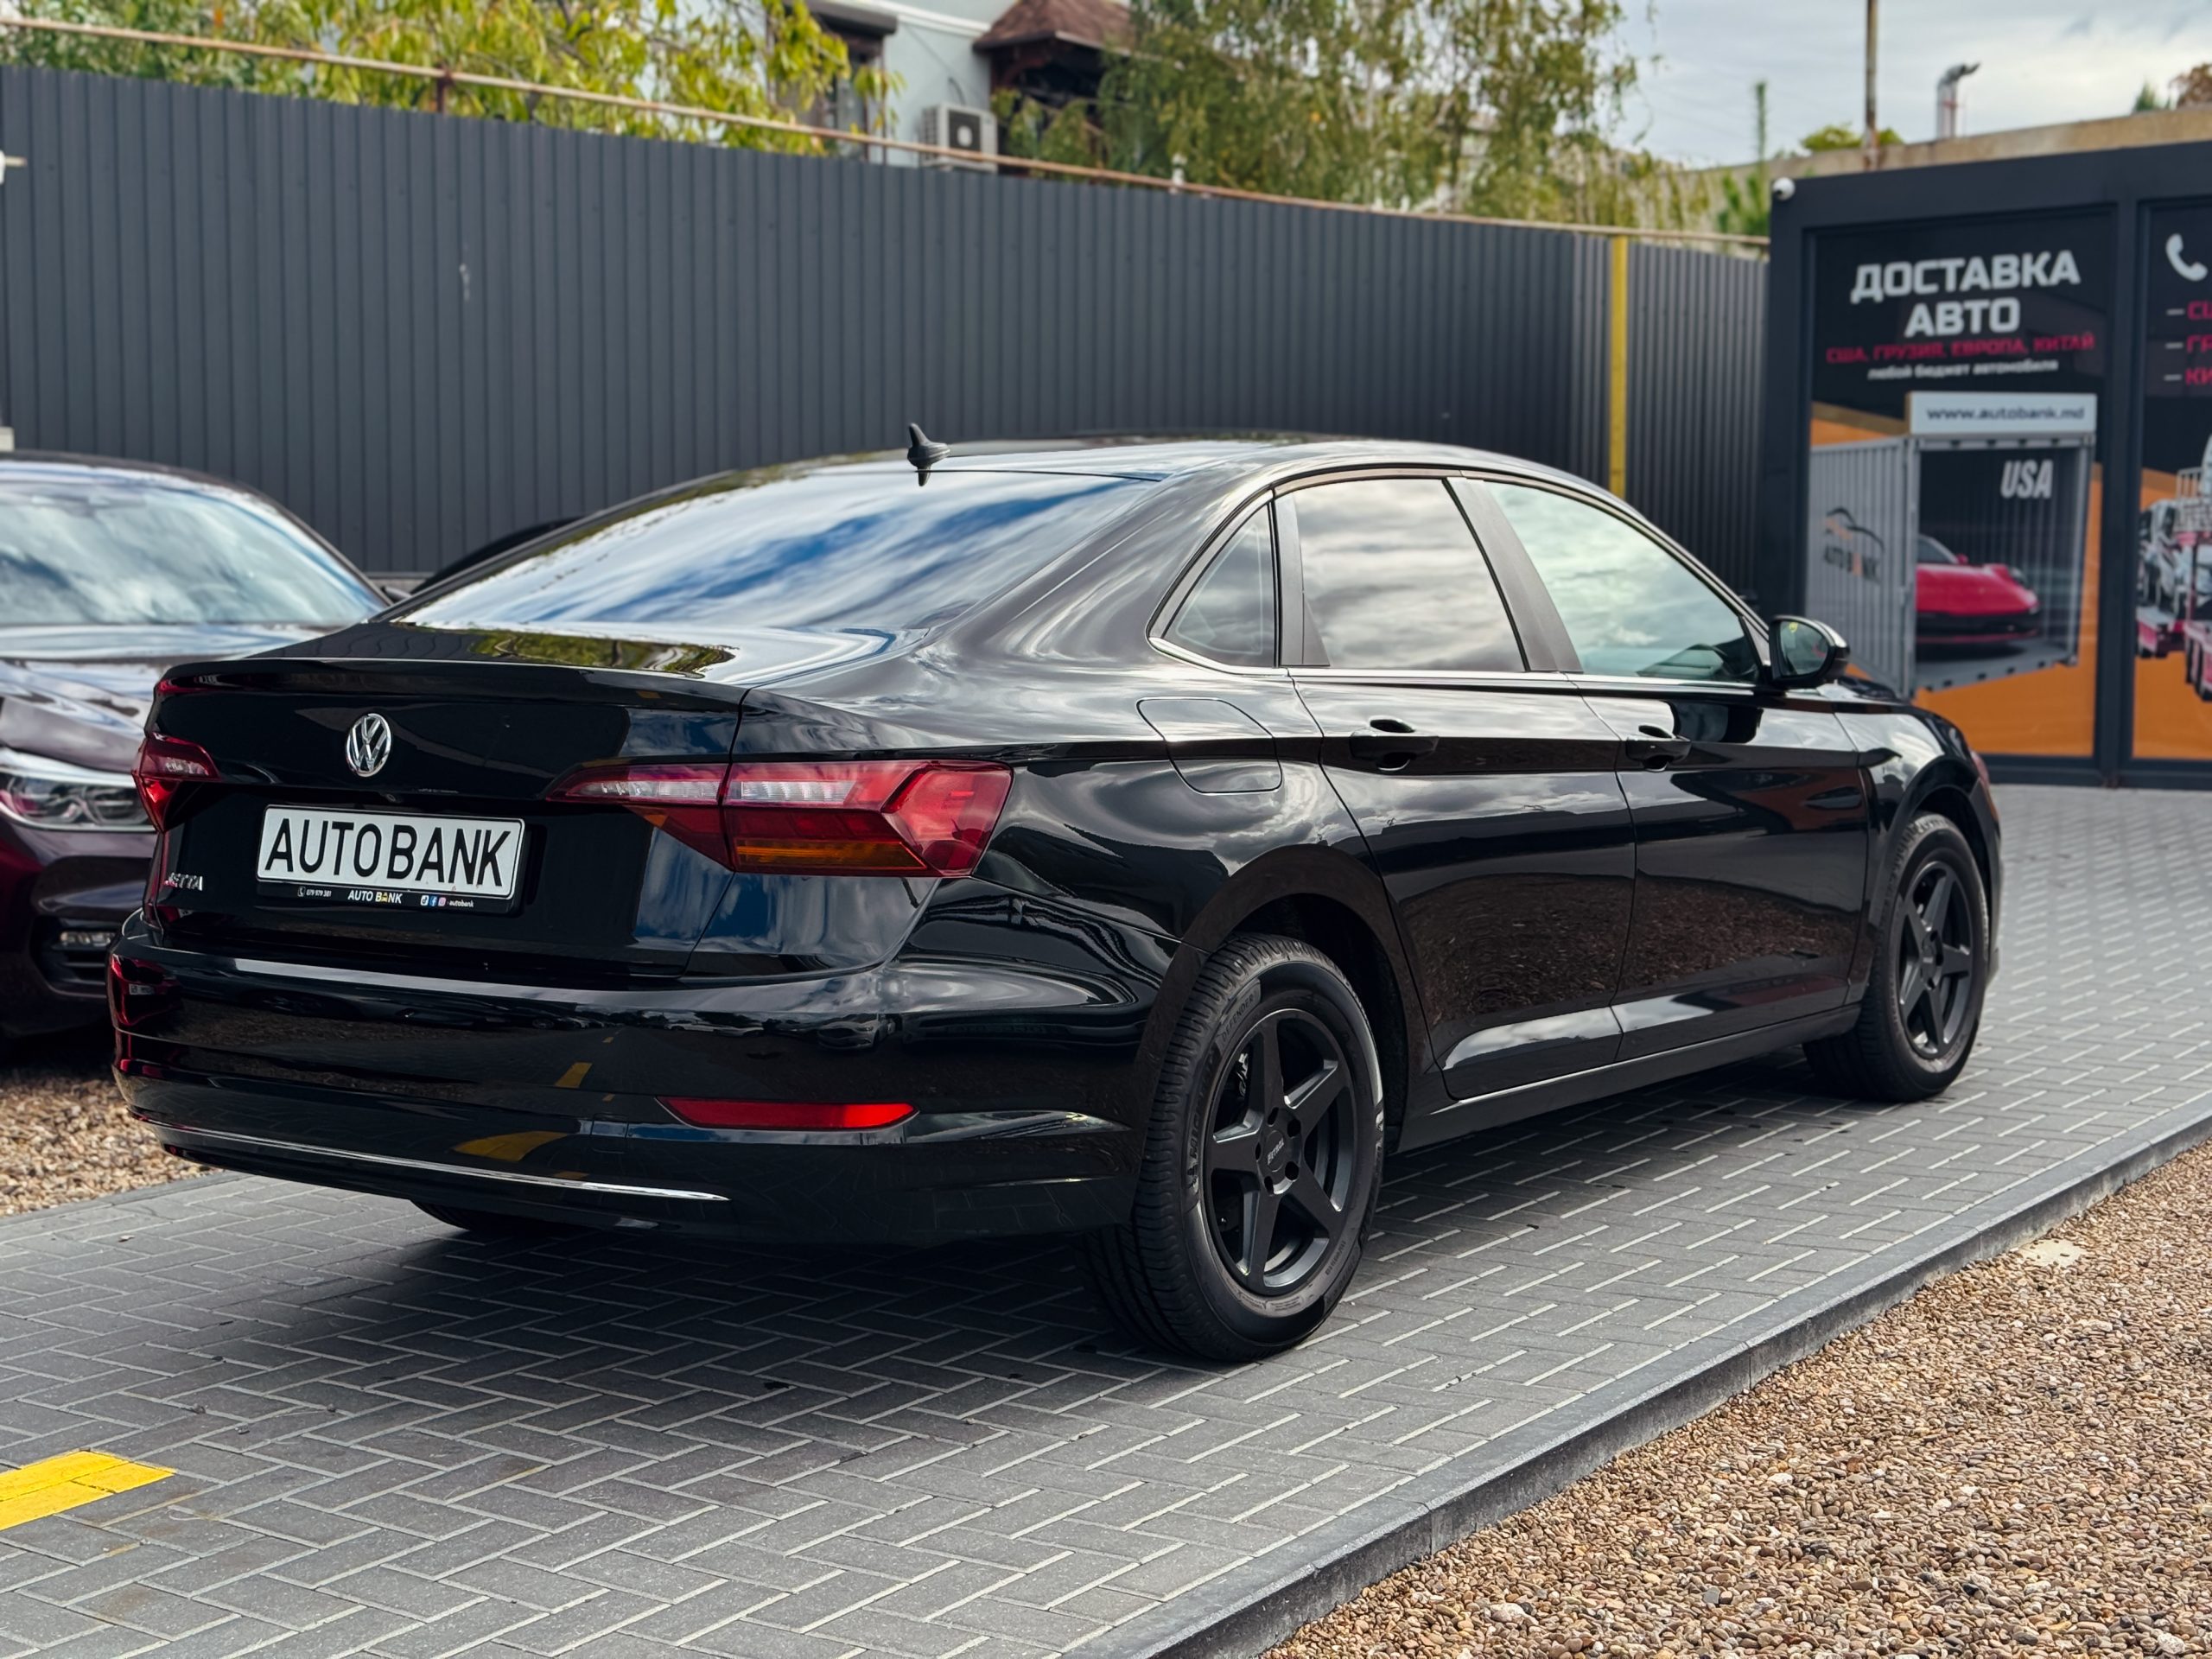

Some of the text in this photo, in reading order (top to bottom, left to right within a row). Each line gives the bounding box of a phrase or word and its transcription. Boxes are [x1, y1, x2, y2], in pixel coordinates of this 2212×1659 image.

[1850, 250, 2081, 304] ДОСТАВКА
[1904, 297, 2020, 338] АВТО
[2033, 332, 2095, 353] КИТАЙ
[1867, 362, 1912, 381] любой
[1927, 405, 2084, 421] www.autobank.md
[2000, 460, 2053, 499] USA
[347, 889, 373, 902] AUTO
